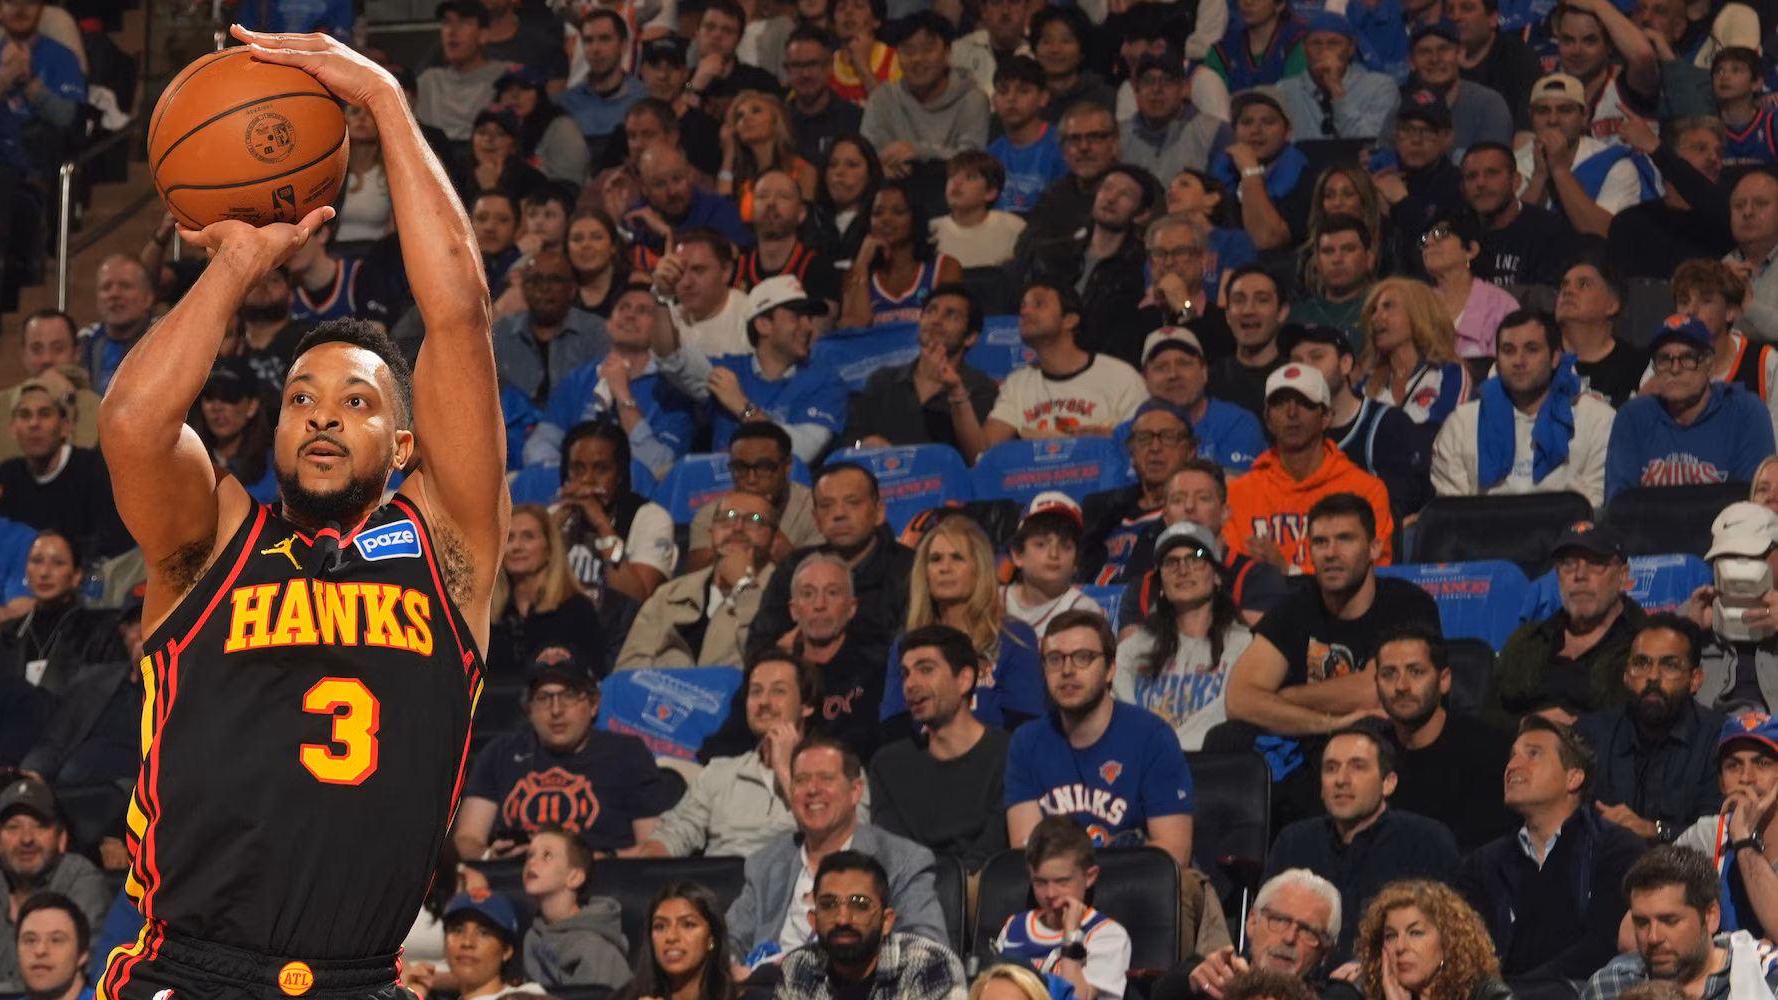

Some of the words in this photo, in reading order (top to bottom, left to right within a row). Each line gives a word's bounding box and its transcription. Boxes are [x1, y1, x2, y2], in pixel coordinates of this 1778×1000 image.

[1023, 401, 1053, 424] NEW
[1056, 399, 1097, 419] YORK
[1641, 456, 1720, 488] KNICKS
[362, 530, 415, 553] paze
[223, 578, 434, 658] HAWKS
[299, 676, 380, 786] 3
[282, 971, 309, 987] ATL
